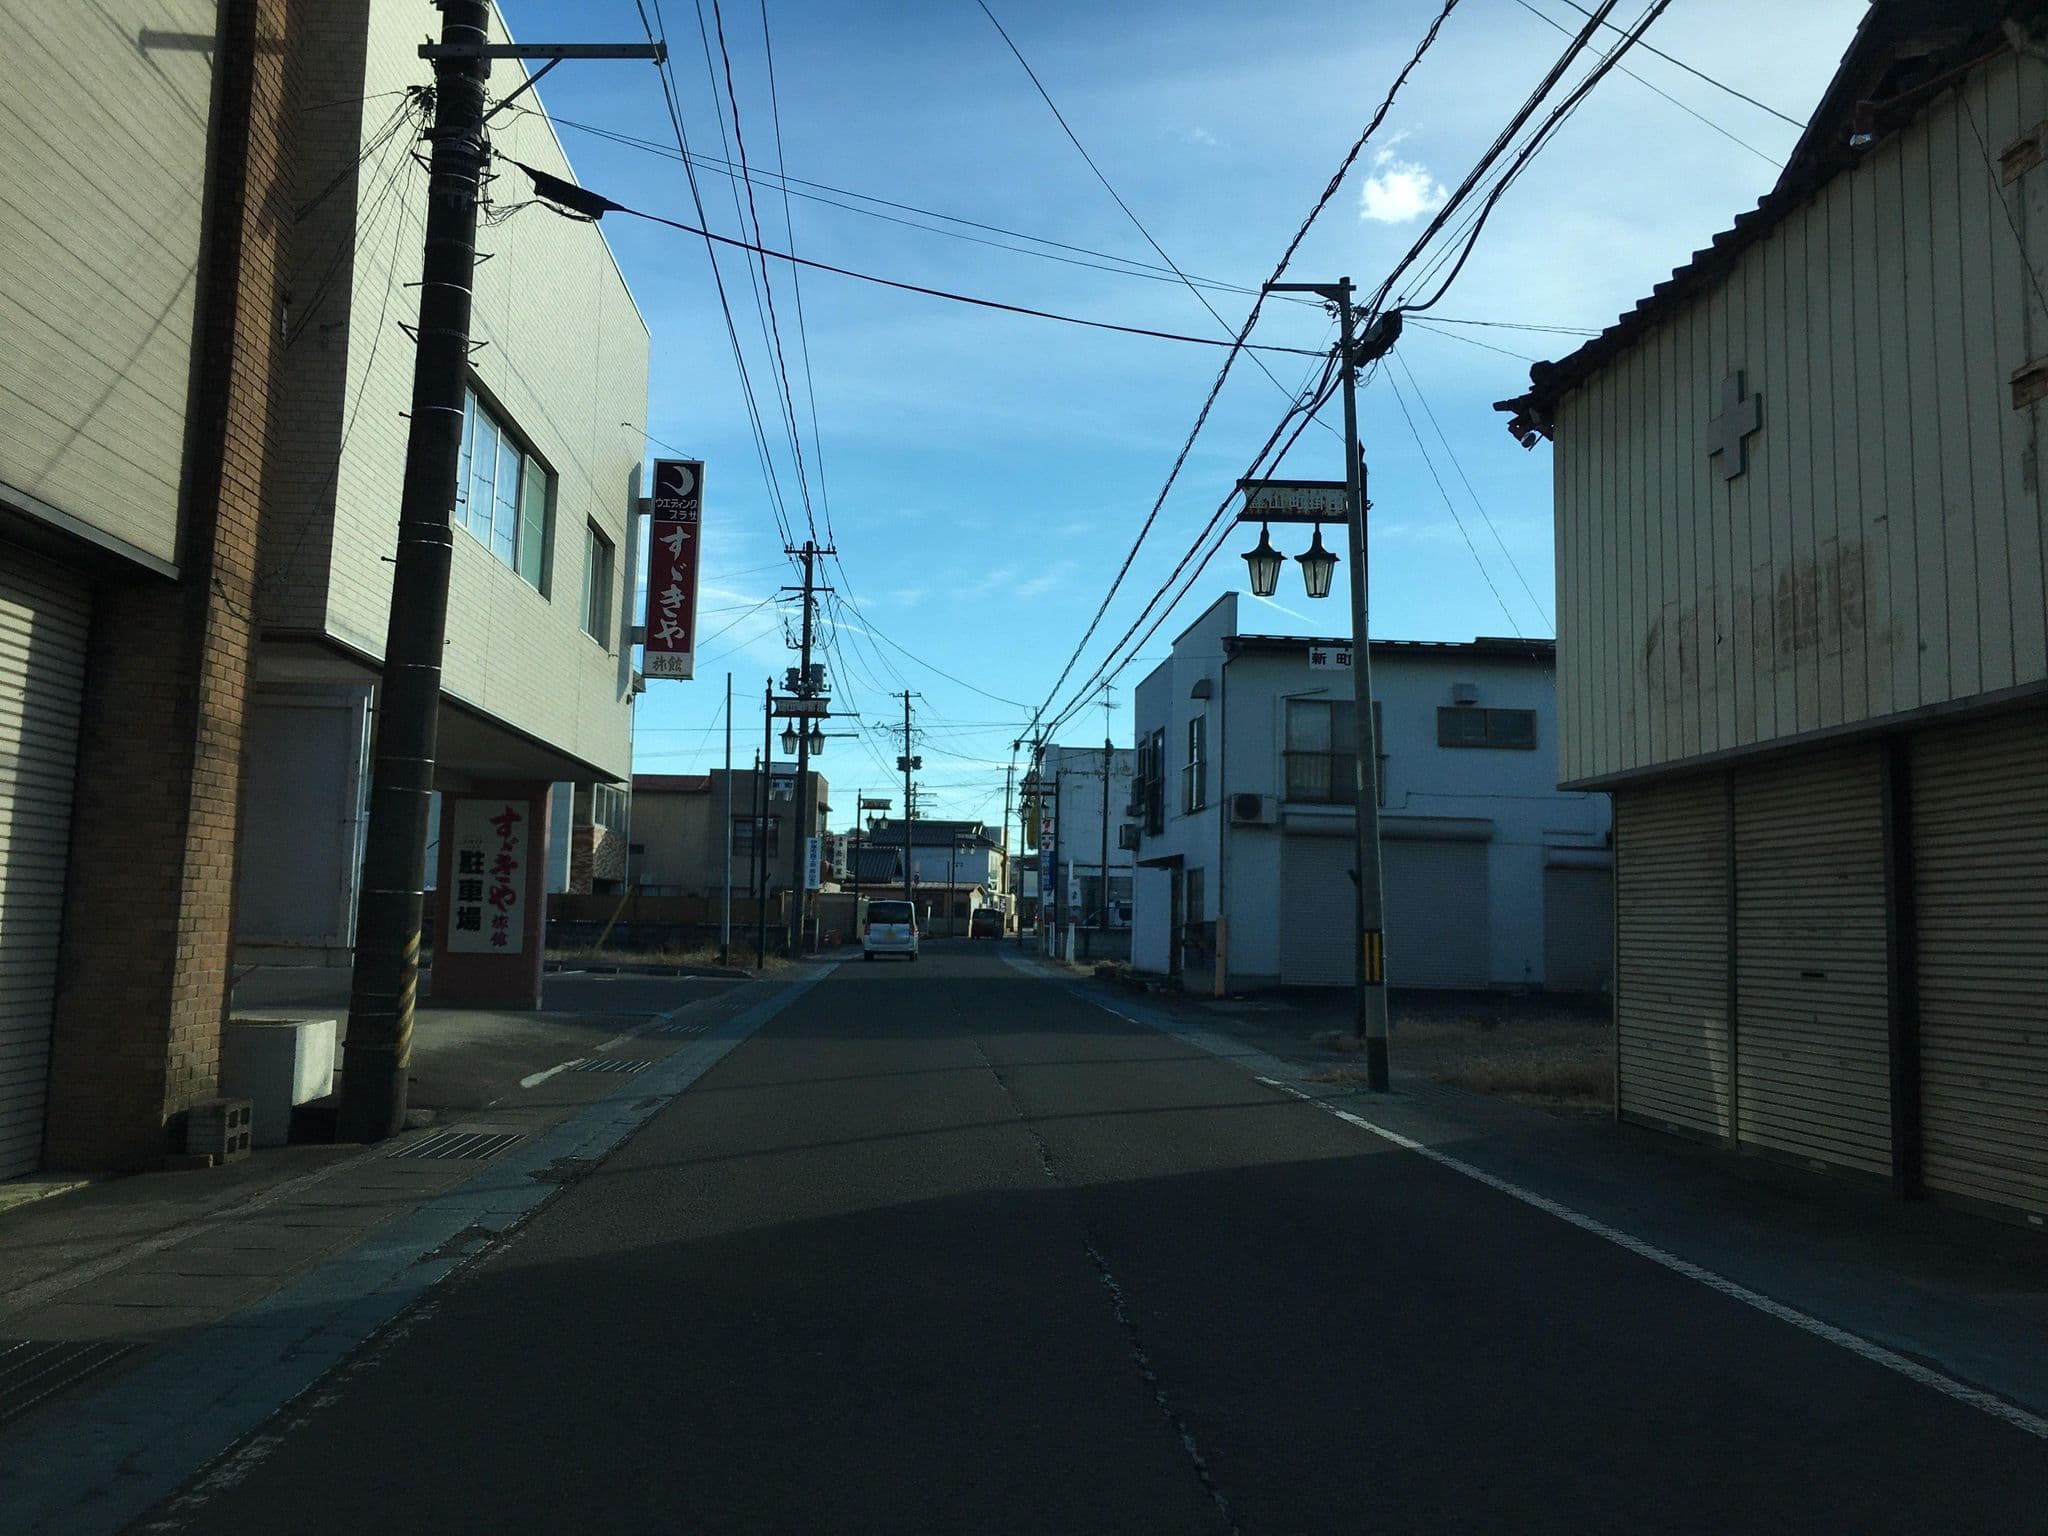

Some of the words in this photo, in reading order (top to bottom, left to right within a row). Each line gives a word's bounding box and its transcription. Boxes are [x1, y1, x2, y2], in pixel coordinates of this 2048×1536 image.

[1311, 652, 1352, 666] 新町
[456, 850, 485, 931] 駐車場
